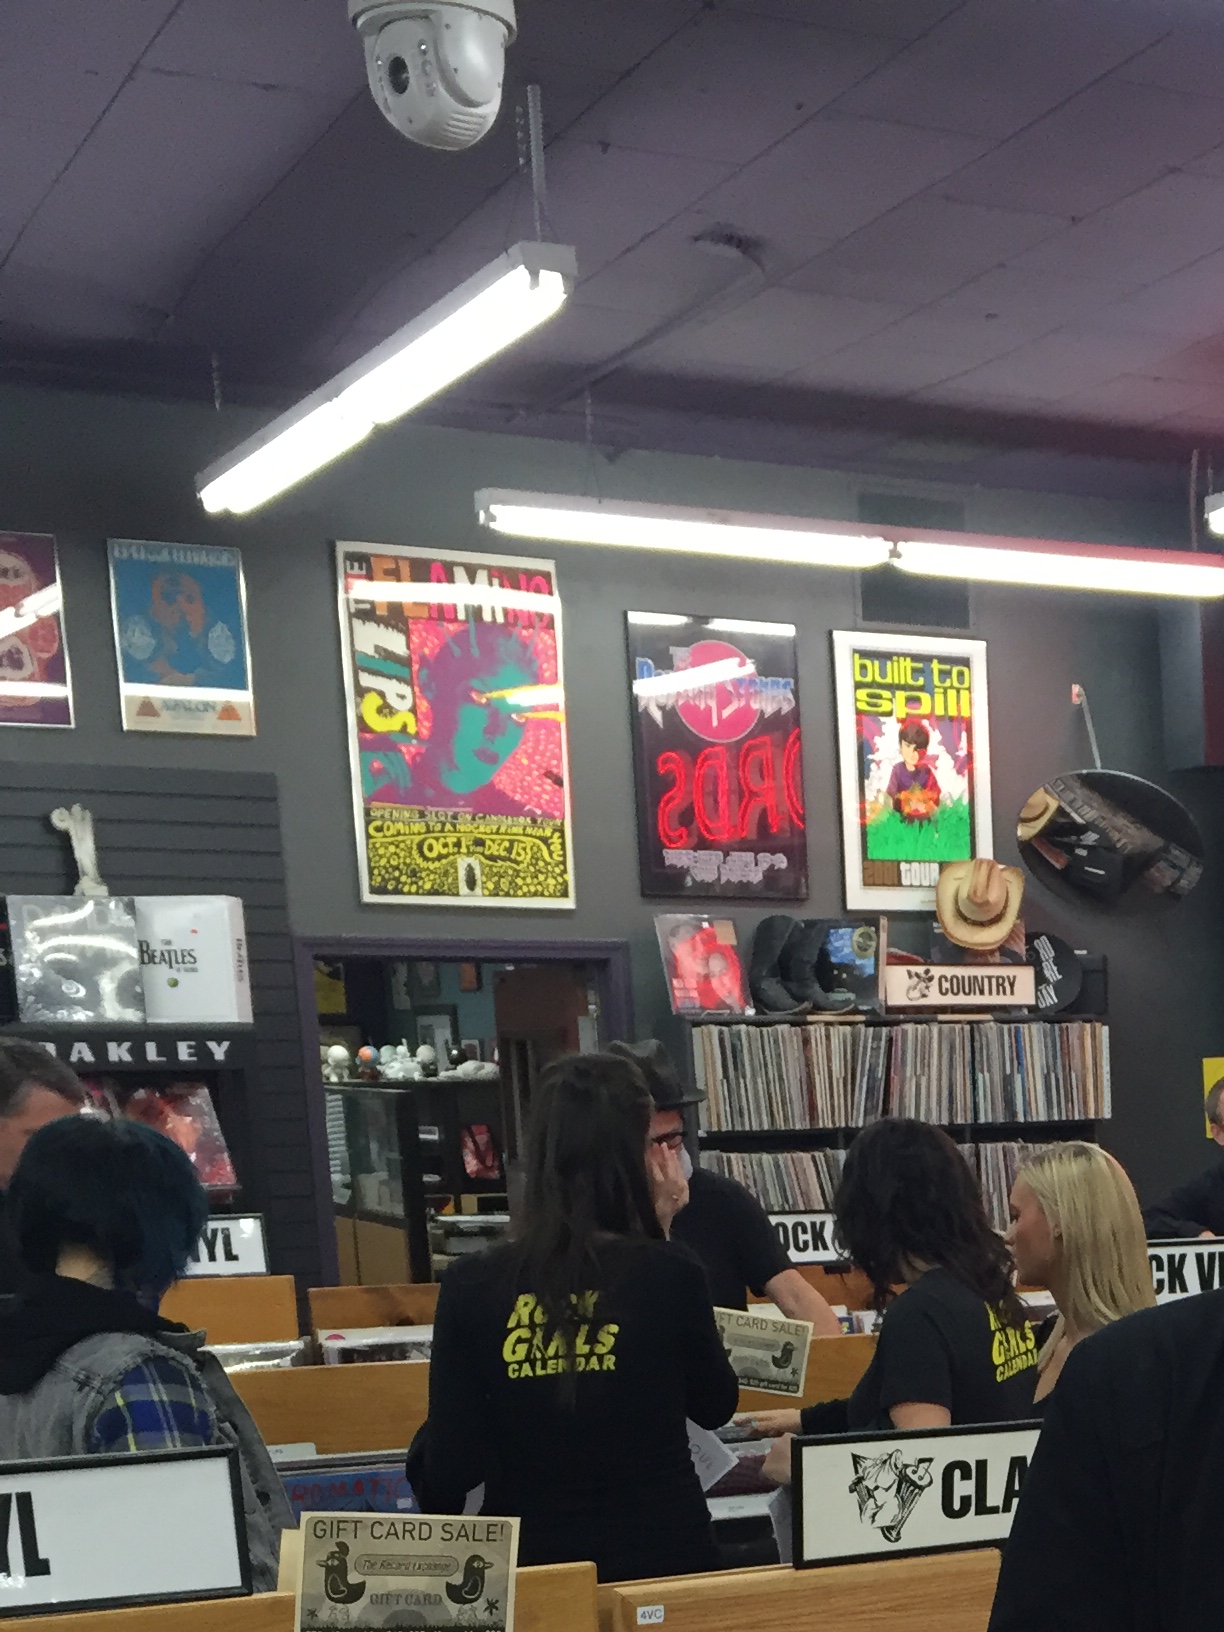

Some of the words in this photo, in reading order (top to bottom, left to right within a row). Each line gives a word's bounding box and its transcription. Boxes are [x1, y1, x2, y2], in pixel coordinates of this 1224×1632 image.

[854, 652, 925, 686] built
[931, 657, 971, 688] to
[855, 687, 971, 719] spill
[138, 938, 198, 970] BEATLES
[937, 974, 1017, 997] COUNTRY
[38, 1041, 231, 1062] AKLEY
[736, 1315, 769, 1331] CARD
[313, 1519, 363, 1540] GIFT
[370, 1520, 433, 1542] CARD
[440, 1522, 504, 1543] SALE!
[370, 1593, 404, 1606] GIFT
[407, 1593, 443, 1606] CARD
